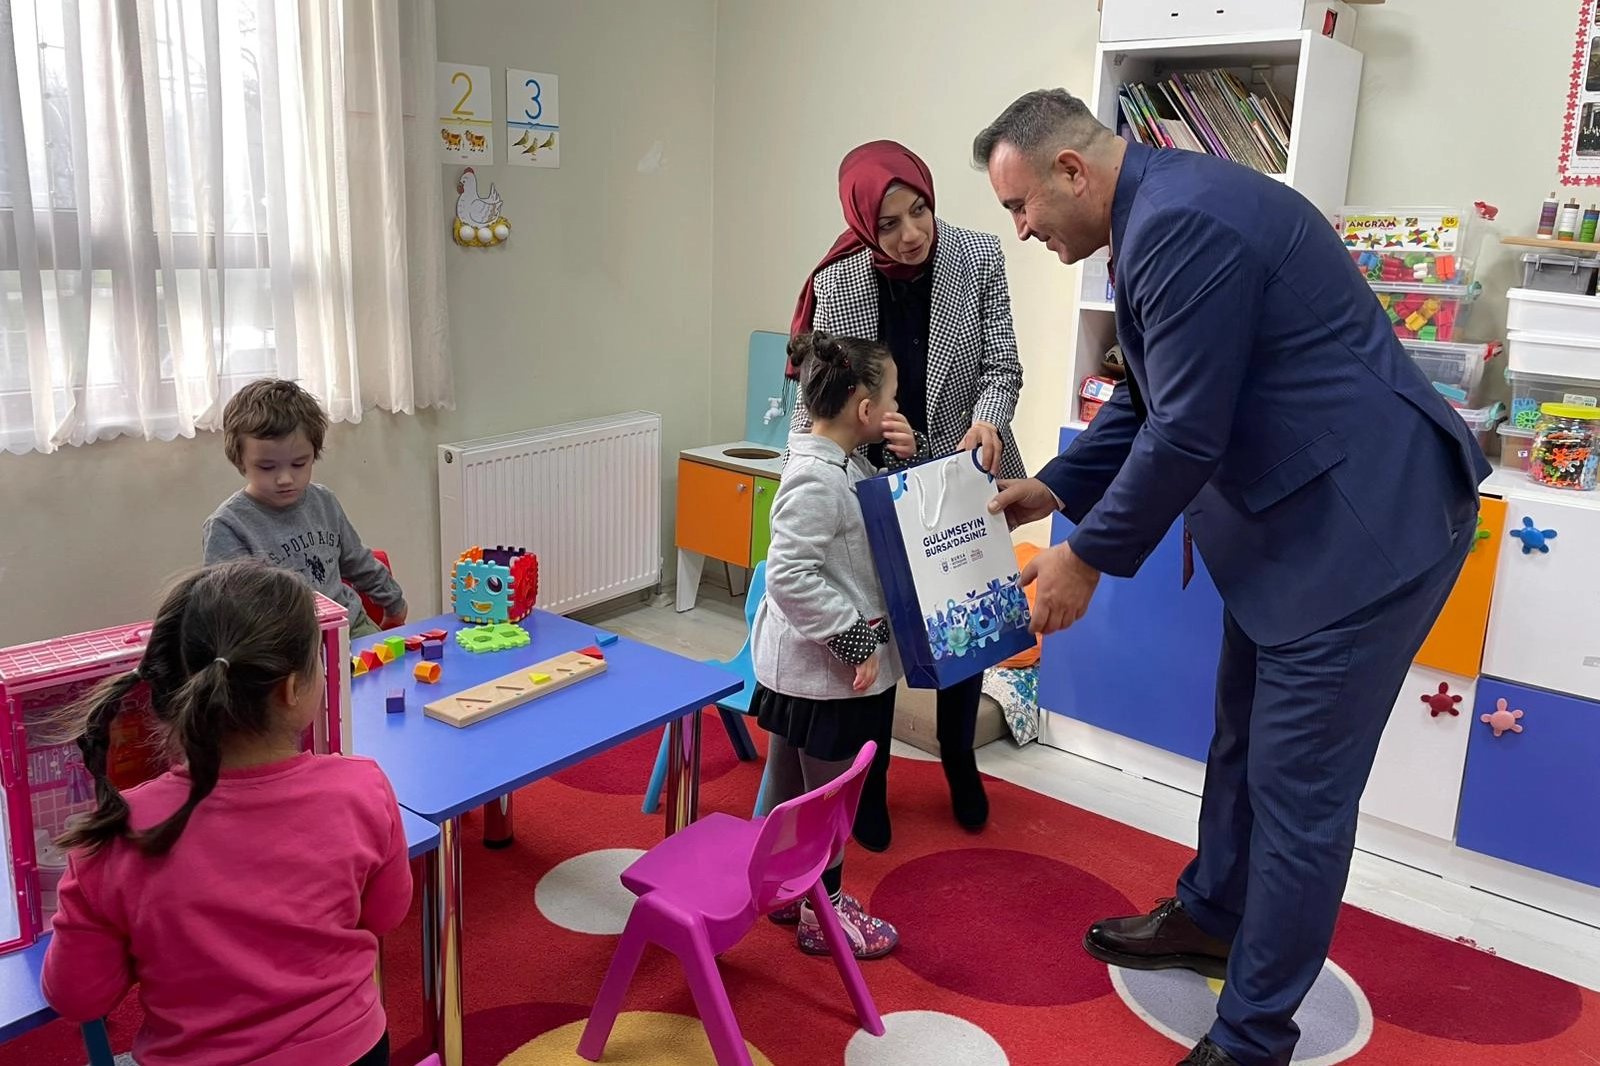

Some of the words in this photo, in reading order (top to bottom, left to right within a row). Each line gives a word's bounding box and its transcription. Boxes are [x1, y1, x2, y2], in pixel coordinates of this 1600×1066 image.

[451, 71, 474, 115] 2
[525, 79, 542, 120] 3
[1346, 217, 1397, 228] ANGRAM
[281, 532, 315, 557] POLO
